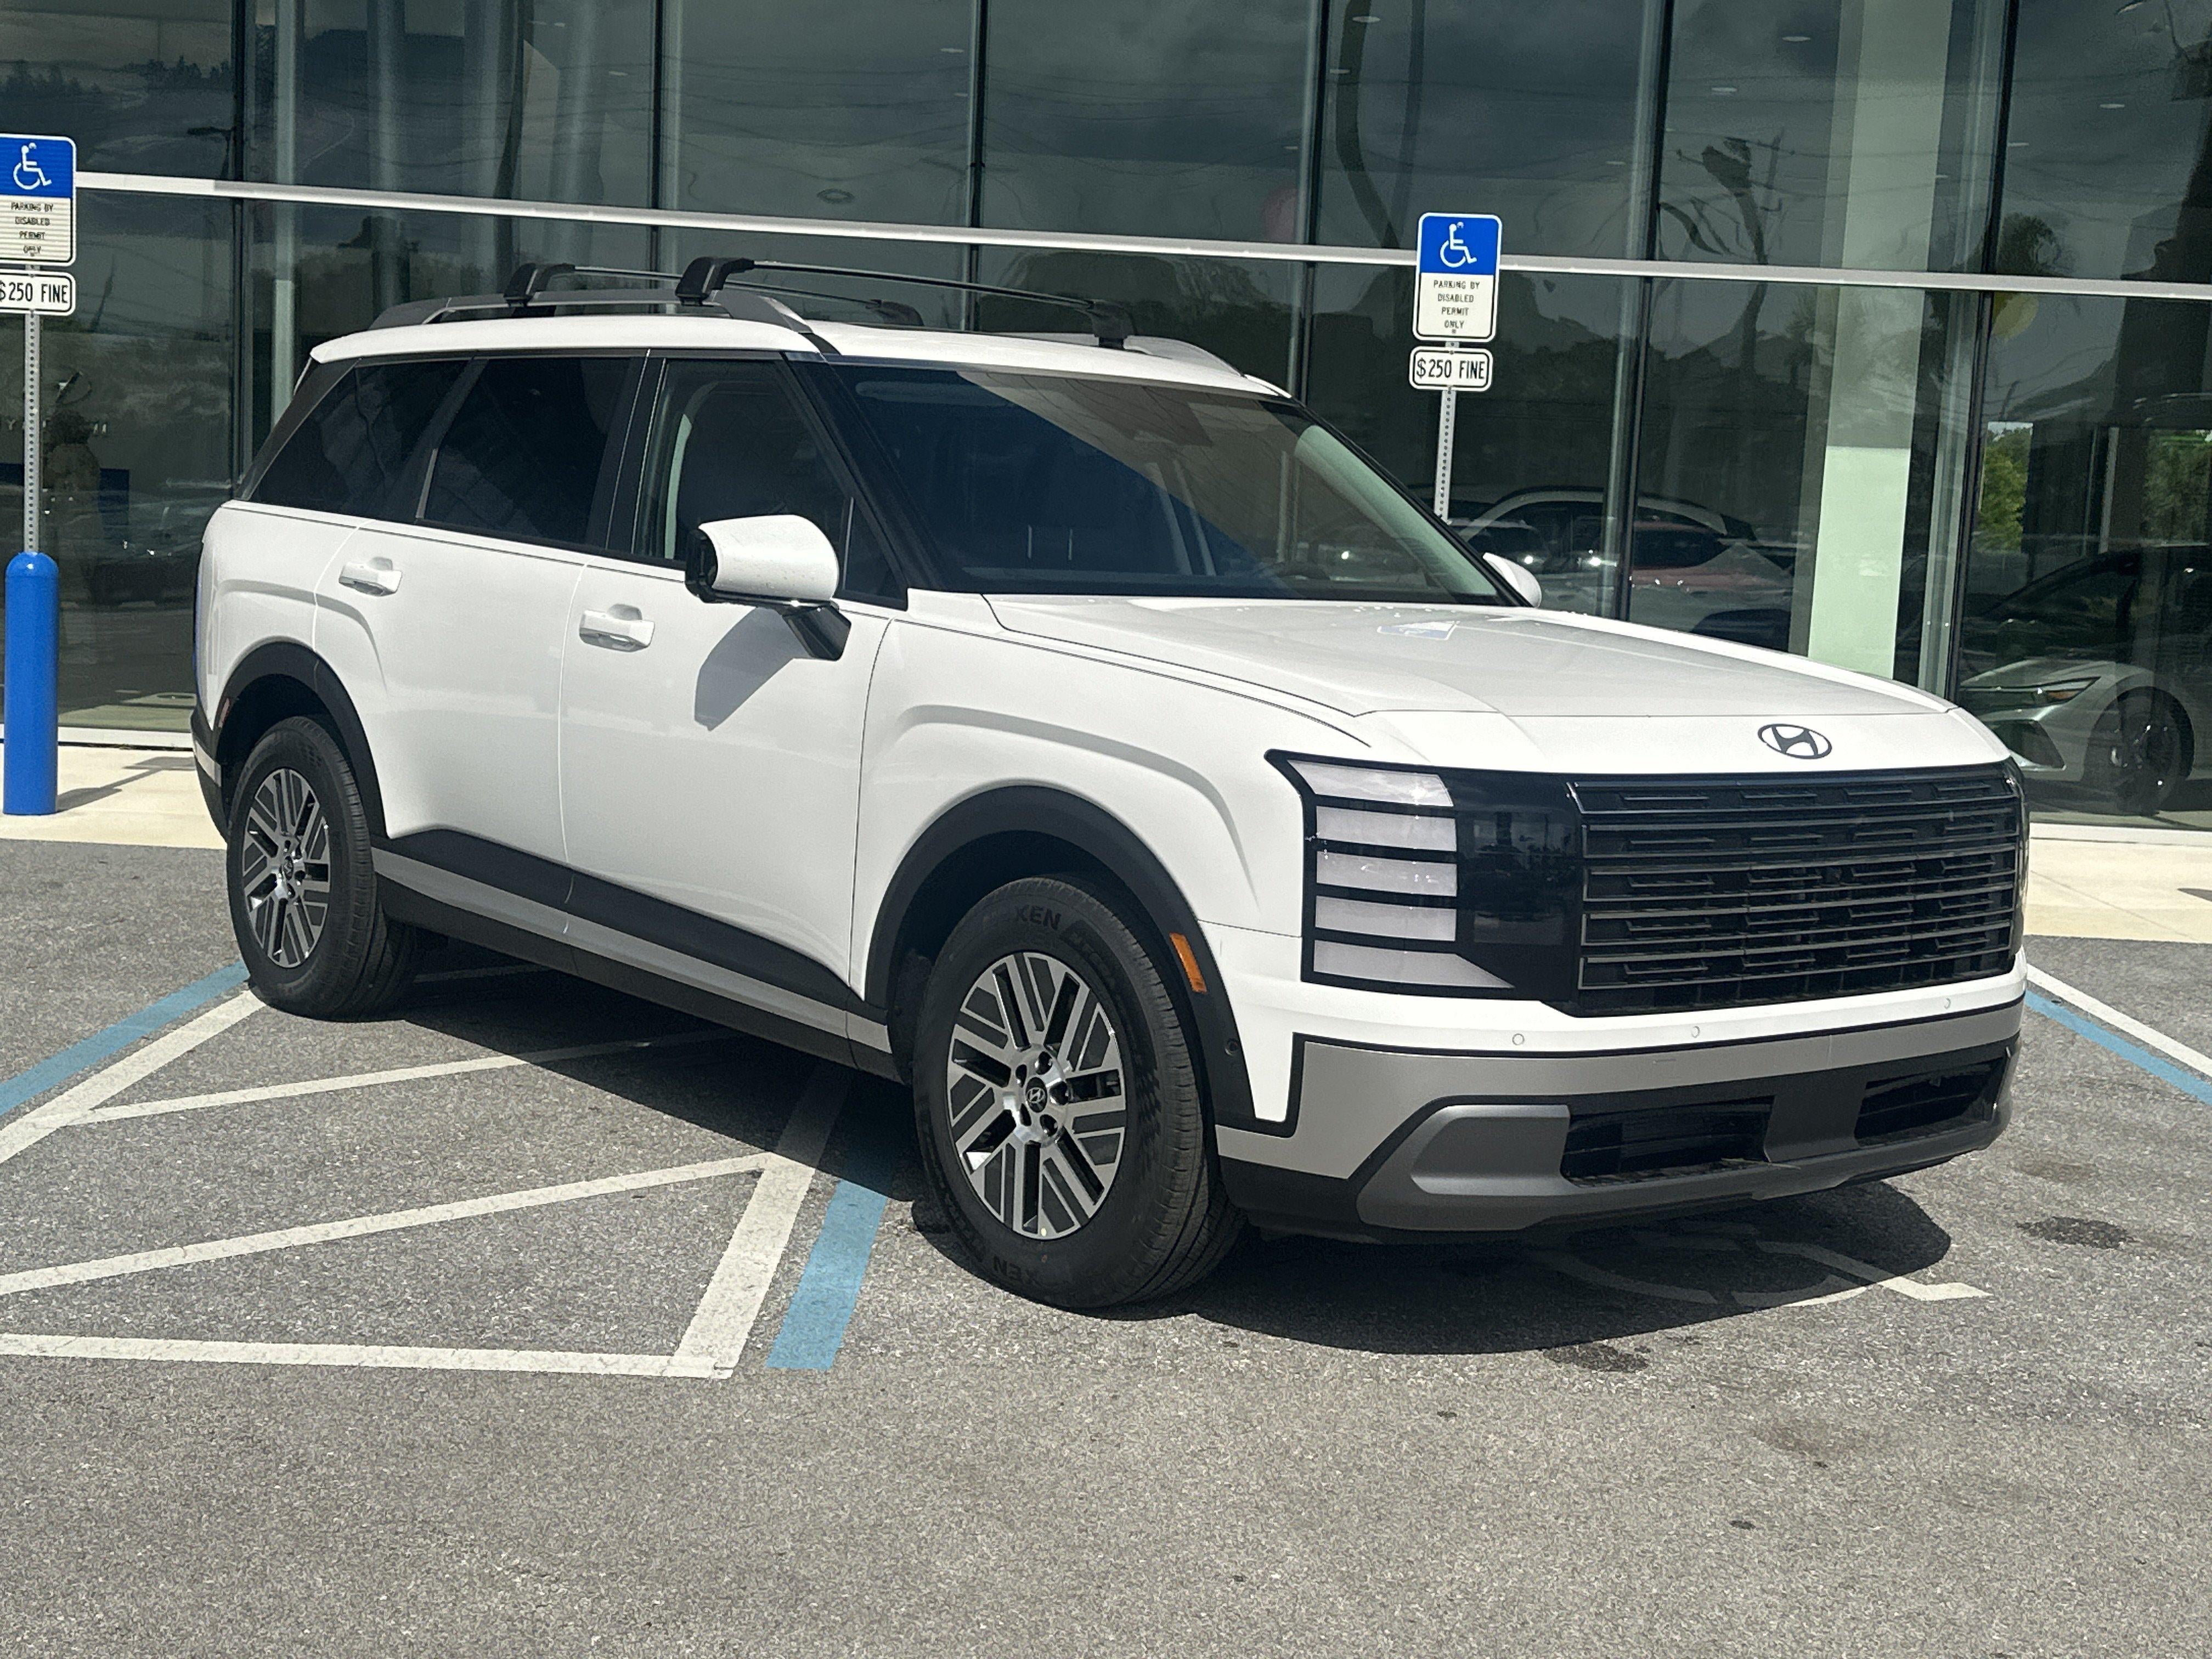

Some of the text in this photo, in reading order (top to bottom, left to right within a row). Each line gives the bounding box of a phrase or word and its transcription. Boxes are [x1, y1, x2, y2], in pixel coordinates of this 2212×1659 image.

[1434, 280, 1466, 289] PARKING
[0, 280, 68, 303] $250 FINE
[1438, 294, 1474, 302] DISABLED
[1442, 307, 1469, 315] PERMIT
[1444, 320, 1464, 329] ONLY
[1416, 357, 1485, 379] $250 FINE
